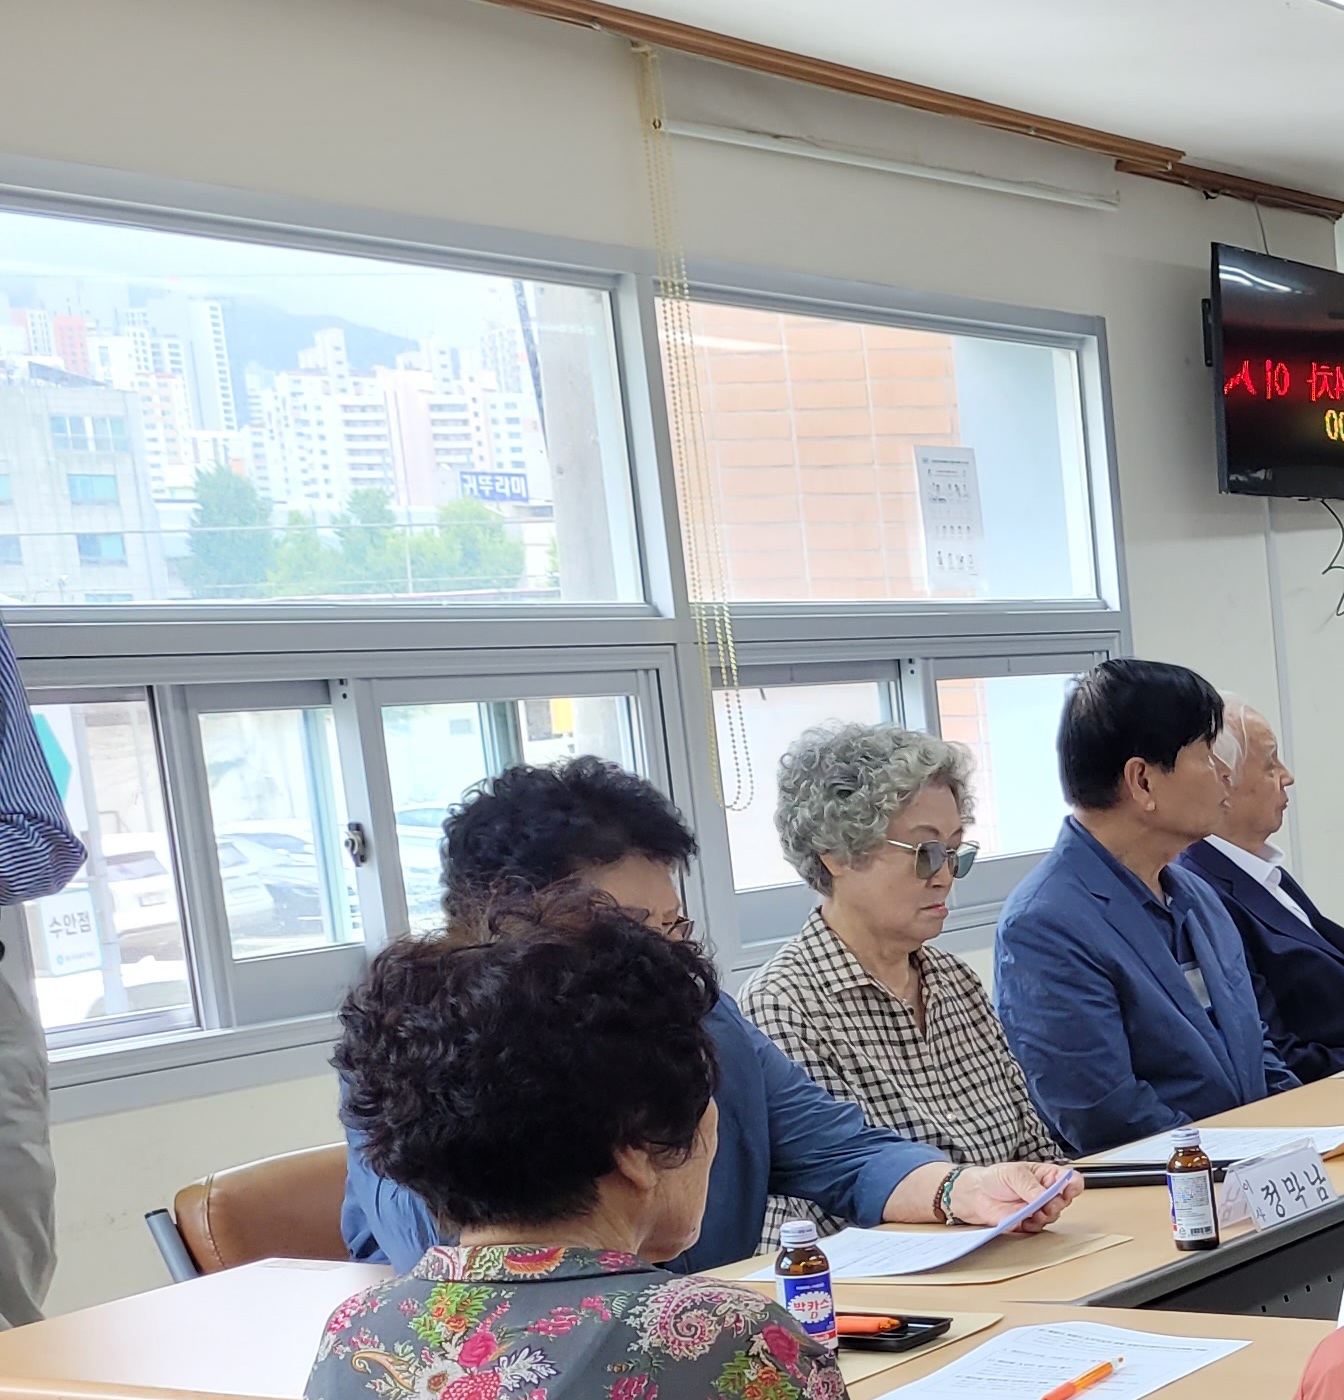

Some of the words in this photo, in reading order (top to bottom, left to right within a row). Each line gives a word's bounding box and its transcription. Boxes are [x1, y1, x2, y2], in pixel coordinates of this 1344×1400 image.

[49, 910, 92, 938] 수안점
[1261, 1164, 1327, 1218] 정막남
[793, 1298, 831, 1312] 박카스
